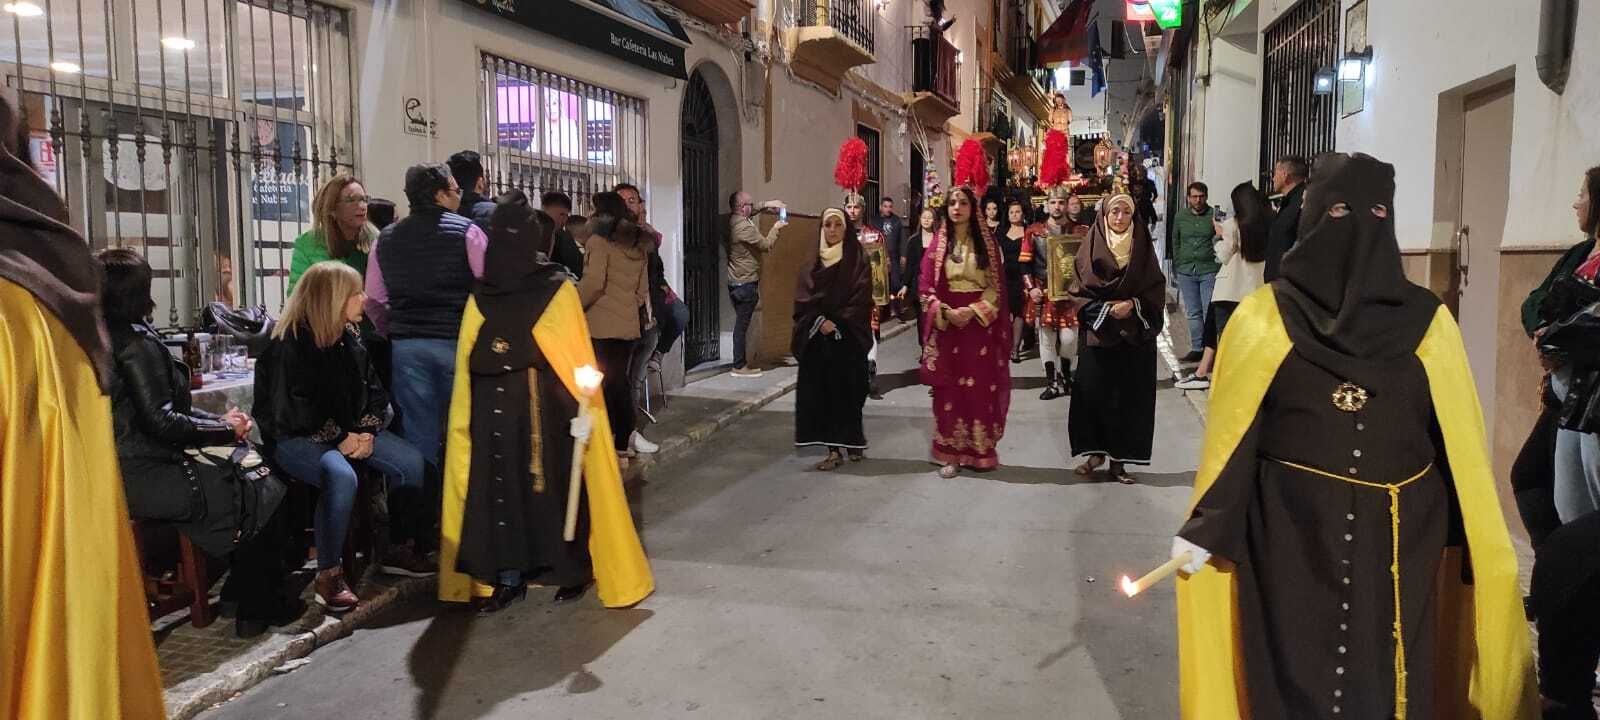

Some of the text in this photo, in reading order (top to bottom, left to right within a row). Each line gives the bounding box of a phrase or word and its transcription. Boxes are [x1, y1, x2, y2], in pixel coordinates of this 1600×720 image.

[610, 32, 621, 48] Bar
[648, 47, 658, 61] Las
[658, 51, 675, 66] Nubes
